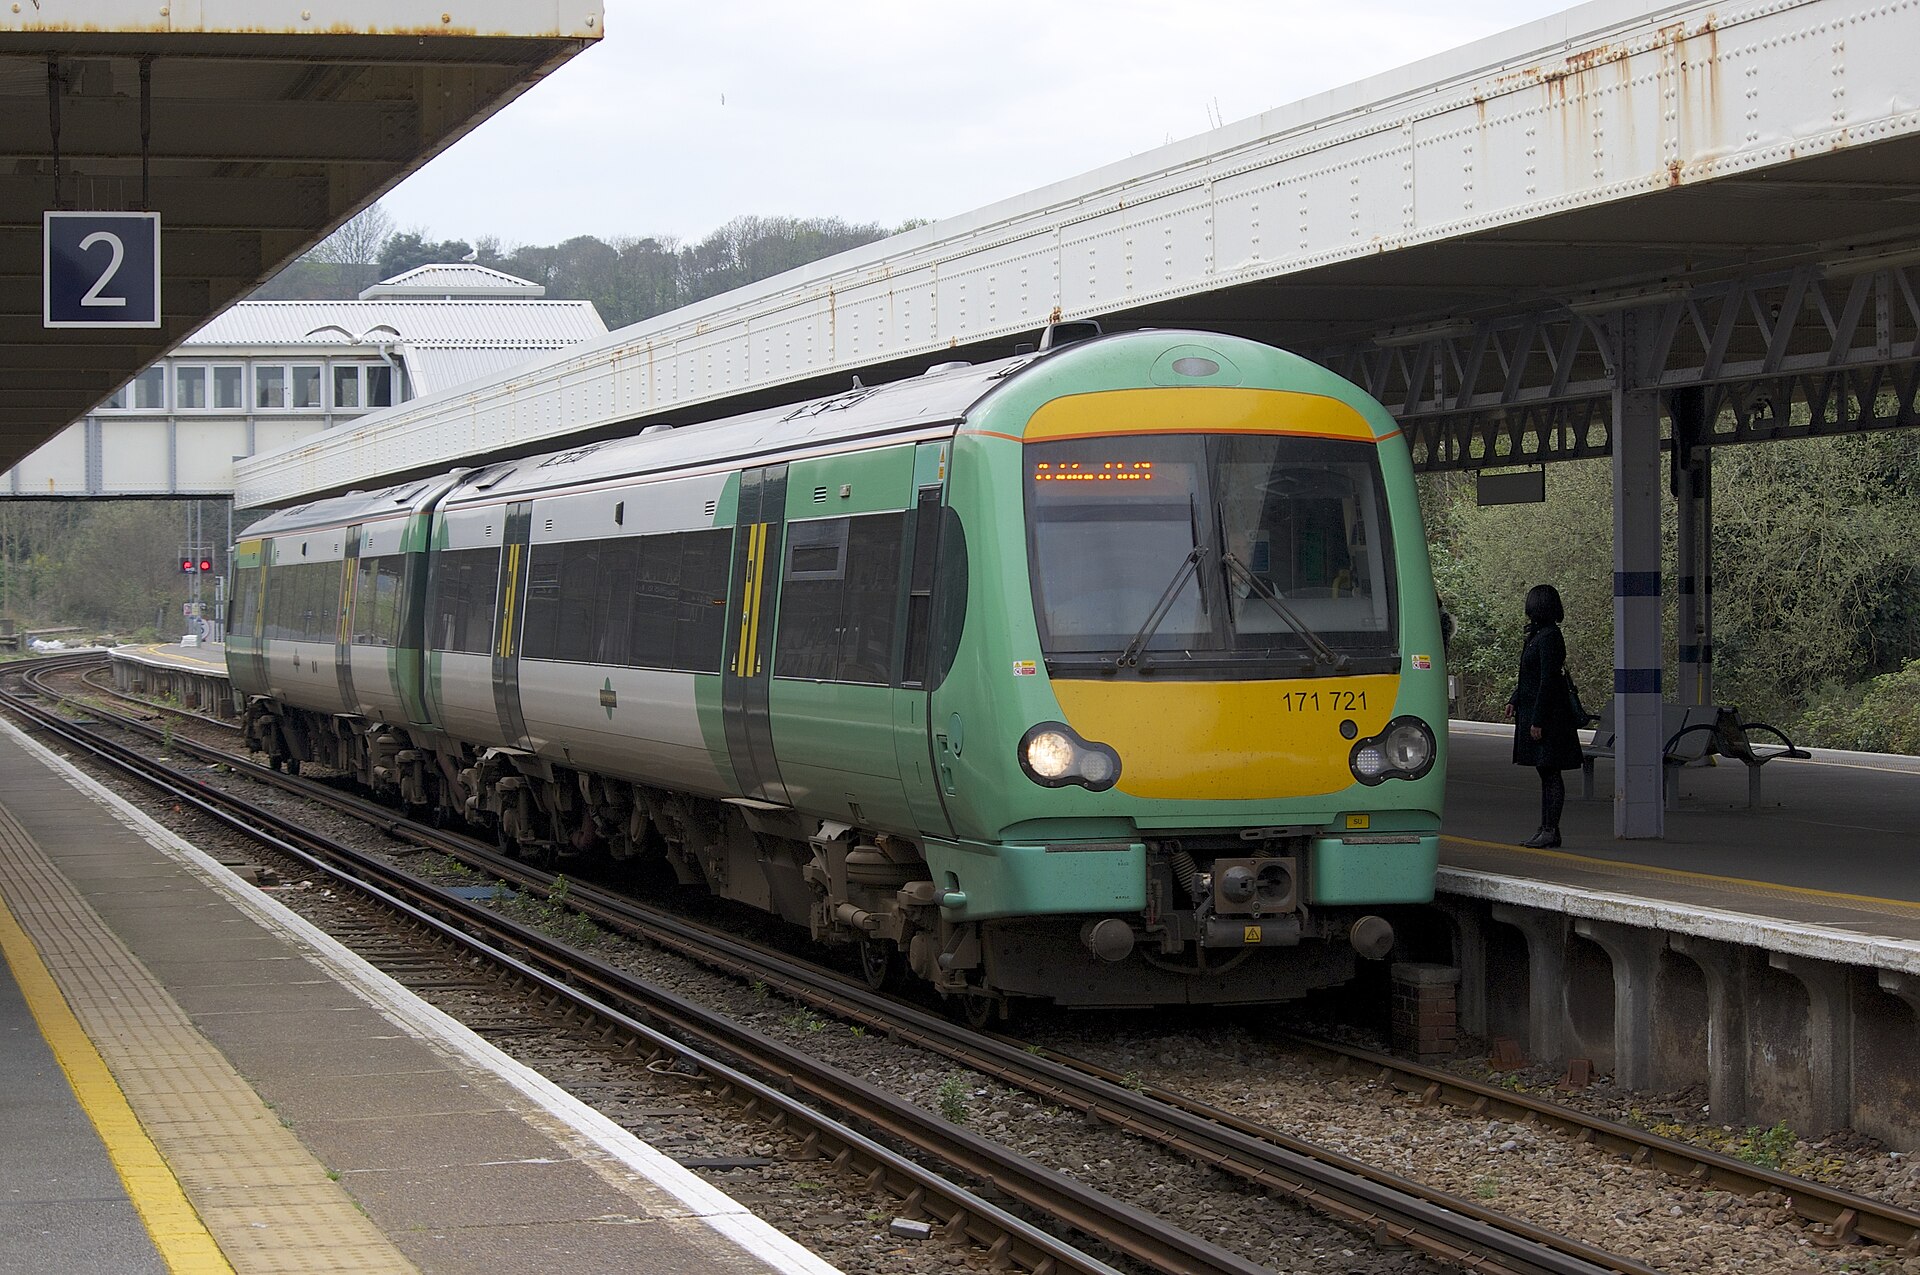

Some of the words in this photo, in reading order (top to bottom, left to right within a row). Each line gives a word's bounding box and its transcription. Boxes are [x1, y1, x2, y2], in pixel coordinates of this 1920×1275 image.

[78, 231, 126, 307] 2
[1282, 691, 1320, 712] 171
[1328, 690, 1367, 711] 721
